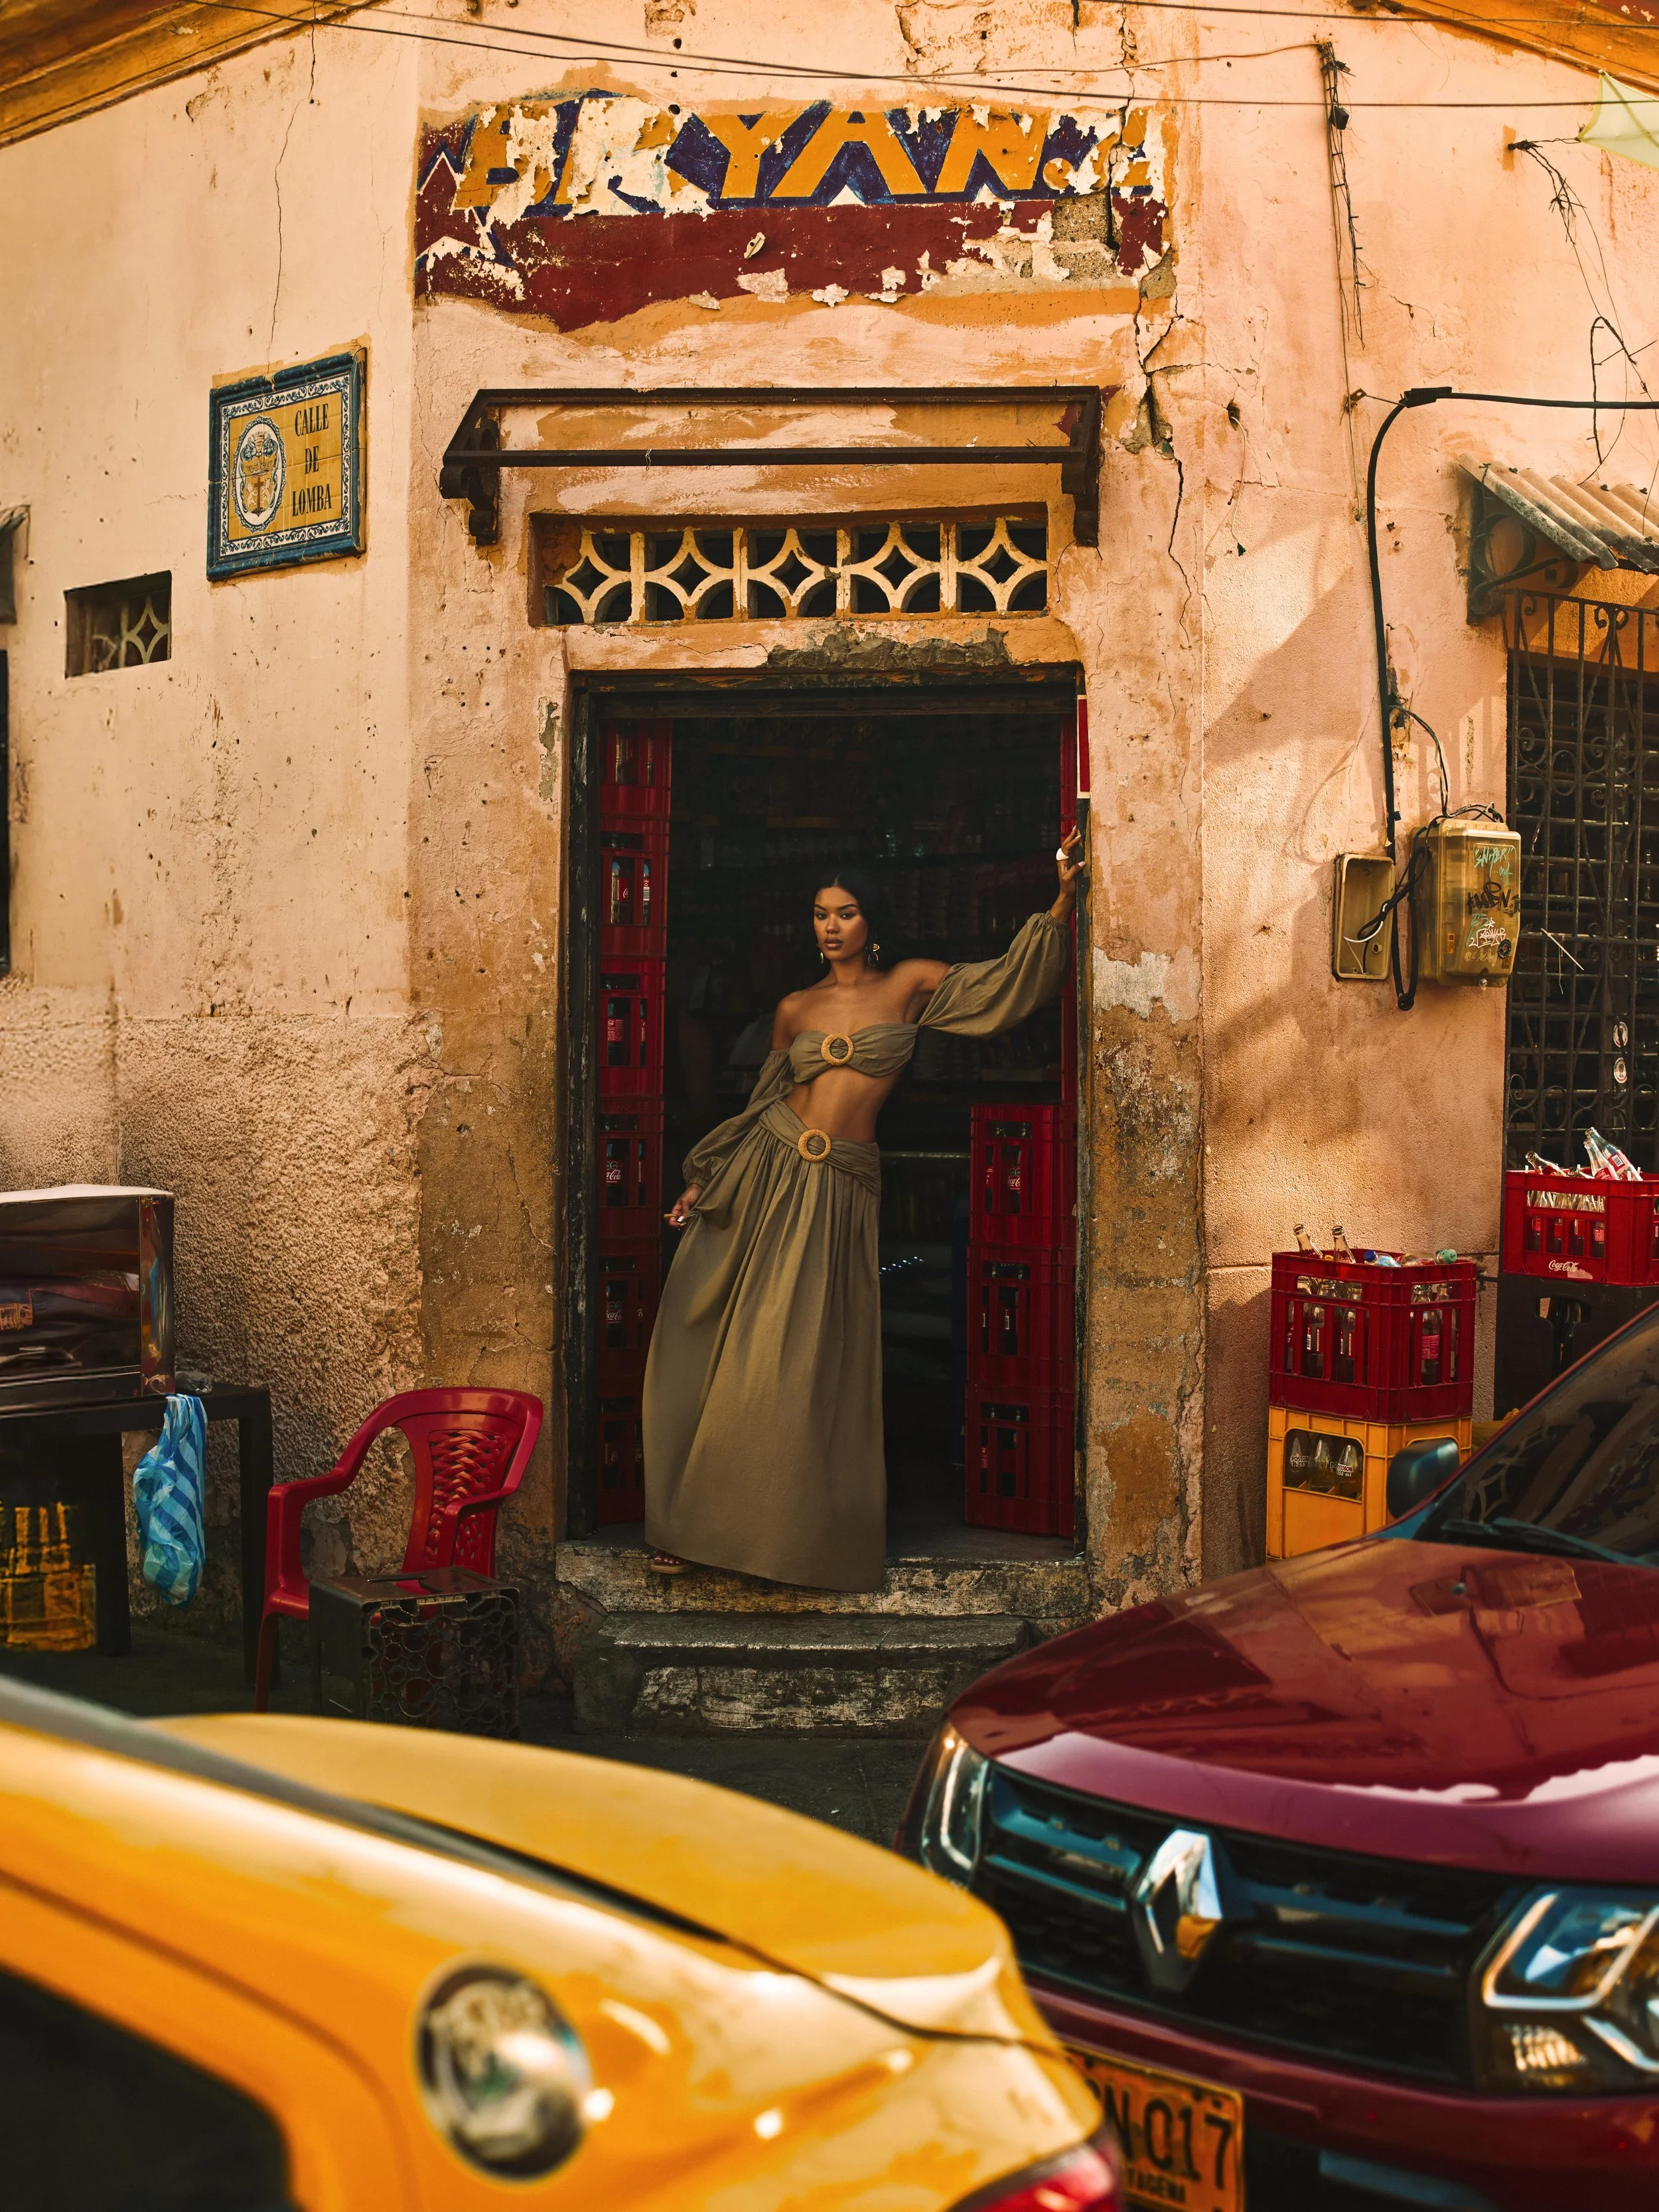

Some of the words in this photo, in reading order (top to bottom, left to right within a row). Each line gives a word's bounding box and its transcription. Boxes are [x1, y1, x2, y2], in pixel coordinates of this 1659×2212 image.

[295, 404, 329, 437] CALLE
[305, 445, 319, 475] DE
[292, 484, 332, 517] LOMBA
[1548, 1260, 1579, 1272] Coca-Cola
